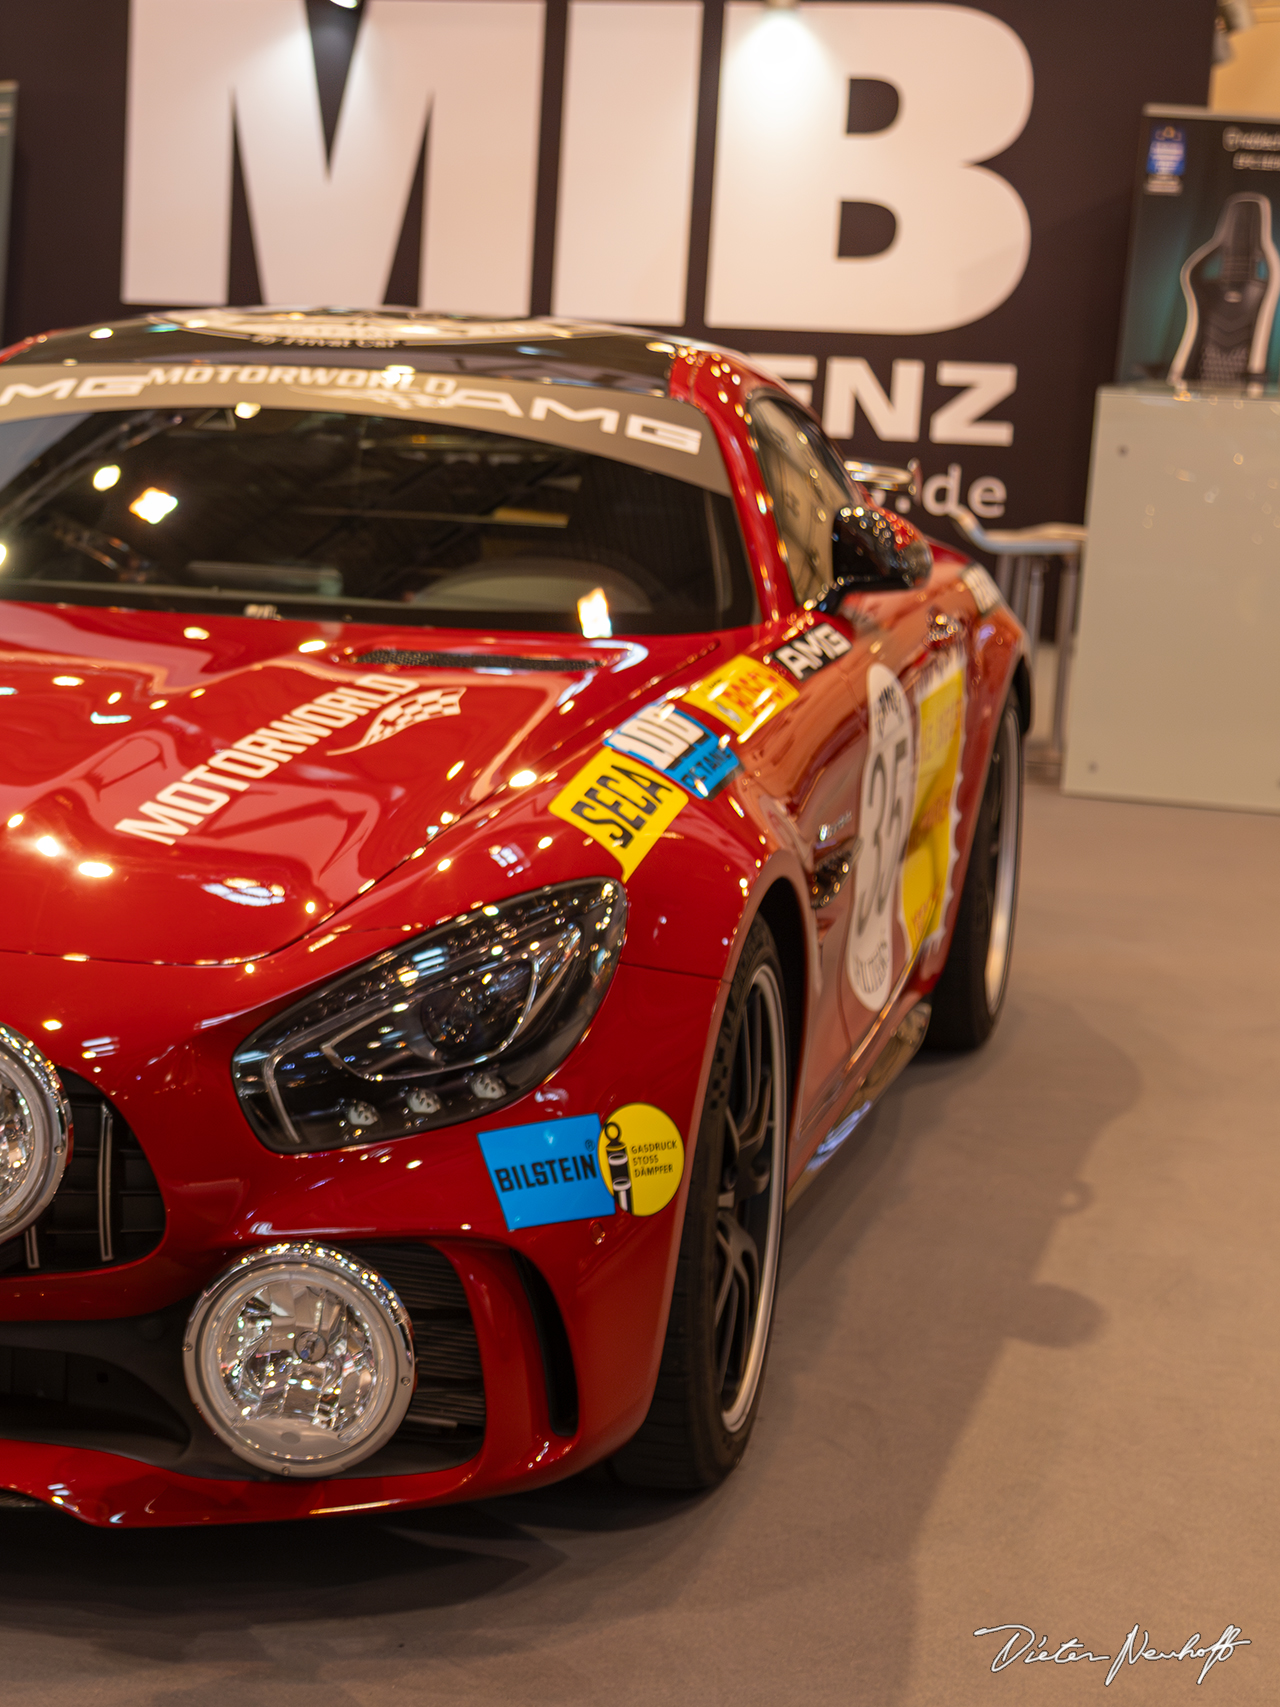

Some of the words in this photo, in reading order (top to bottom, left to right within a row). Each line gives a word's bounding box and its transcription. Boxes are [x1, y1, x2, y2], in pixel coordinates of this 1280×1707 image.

[122, 0, 1034, 334] MIB
[147, 365, 458, 396] MOTORWORLD
[445, 387, 702, 456] AMG
[872, 462, 1007, 519] .de
[775, 624, 852, 680] AMG
[115, 674, 420, 846] MOTORWORLD
[608, 702, 705, 771] 100
[571, 764, 673, 849] SECA
[494, 1153, 597, 1193] BILSTEIN
[631, 1139, 678, 1155] GASDRUCK
[632, 1155, 659, 1167] STOSS
[634, 1164, 674, 1178] DÄMPFER
